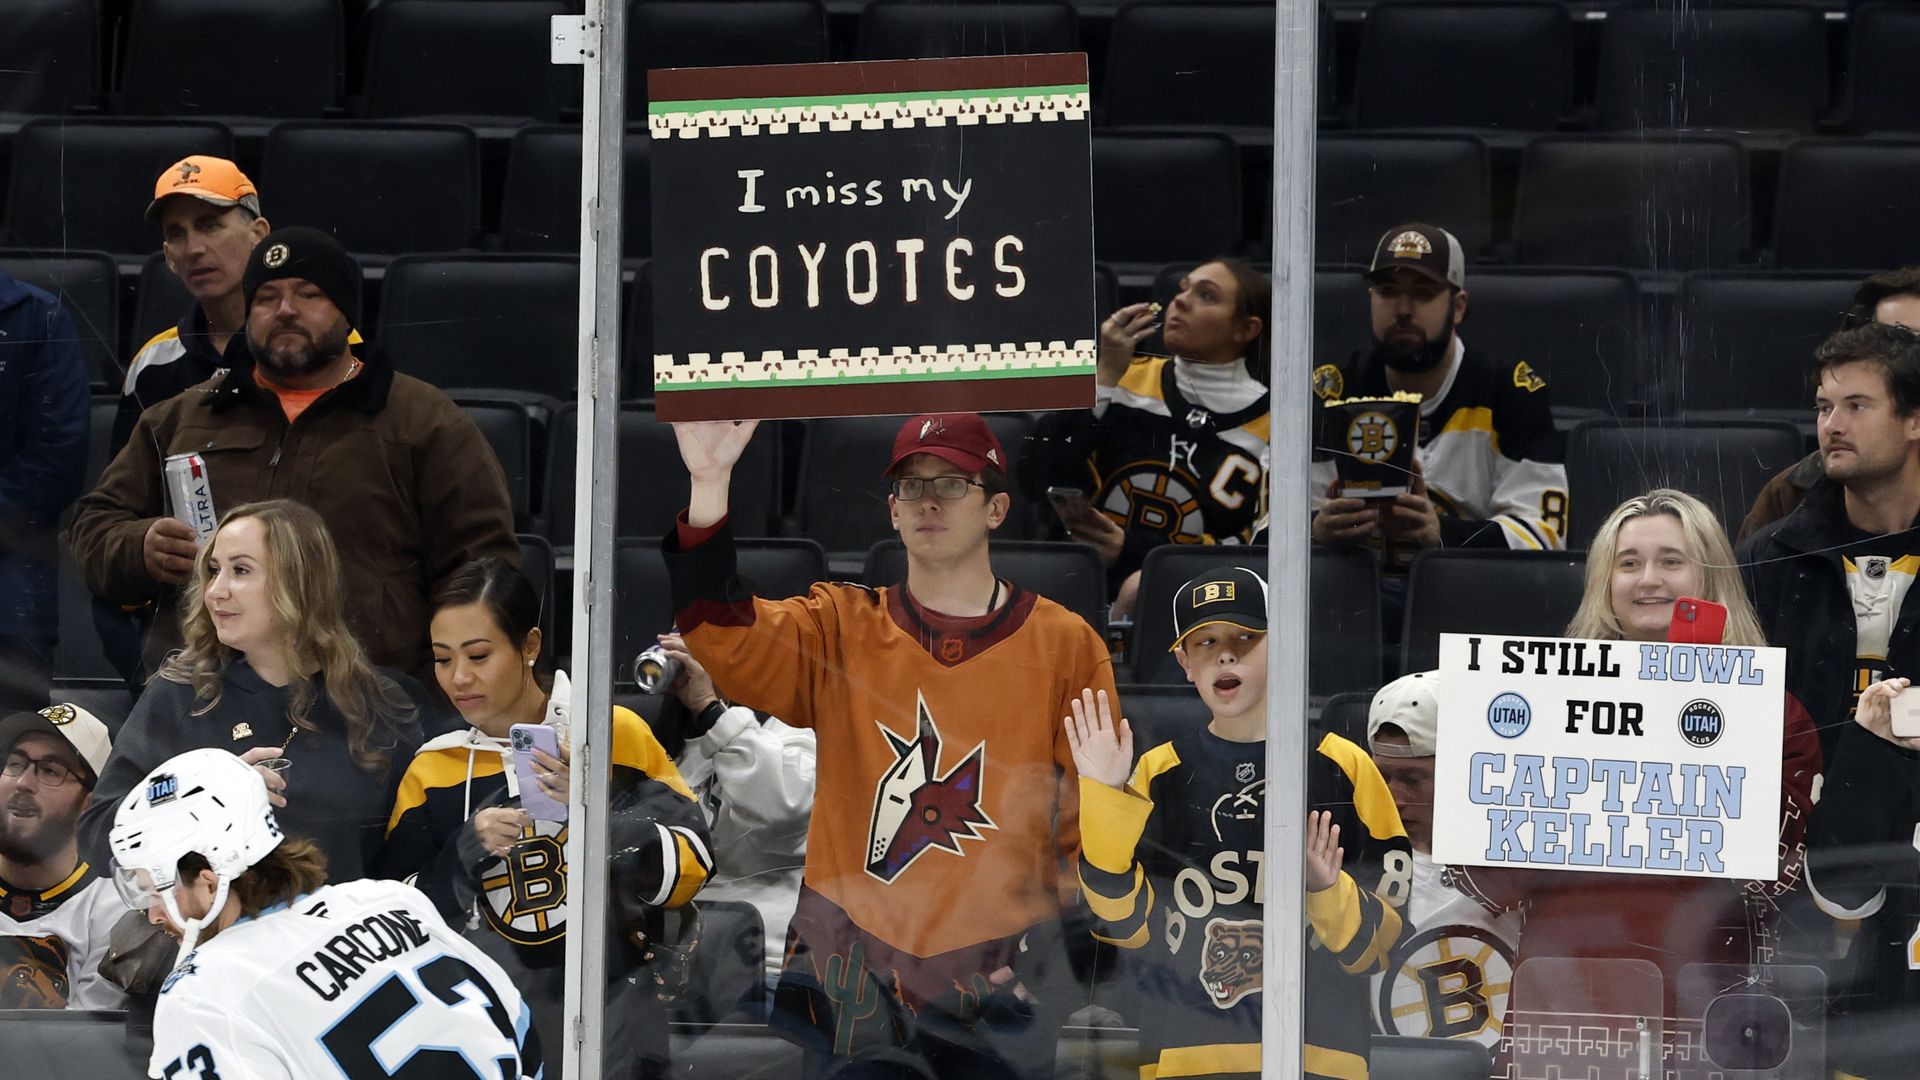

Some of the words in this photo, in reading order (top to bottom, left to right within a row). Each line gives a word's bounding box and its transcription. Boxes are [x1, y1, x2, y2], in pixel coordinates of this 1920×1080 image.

[737, 169, 766, 213] I
[786, 171, 883, 208] miss
[902, 178, 972, 219] my
[700, 235, 1026, 311] COYOTES
[1360, 422, 1386, 453] B
[1209, 454, 1260, 509] C
[195, 484, 213, 541] LTRA
[1204, 584, 1220, 600] B
[1468, 637, 1481, 671] I
[1502, 640, 1620, 678] STILL
[1638, 644, 1764, 685] HOWL
[1494, 707, 1525, 725] UTAH
[1565, 699, 1644, 736] FOR
[1685, 715, 1718, 734] UTAH
[1689, 703, 1716, 714] HOCKEY
[1691, 735, 1711, 743] CLUB
[147, 778, 178, 801] UTAH
[1469, 752, 1746, 819] CAPTAIN
[1485, 809, 1725, 873] KELLER
[507, 837, 567, 916] B
[1375, 849, 1413, 908] 8
[296, 910, 430, 1001] CARCONE
[1416, 954, 1491, 1039] B
